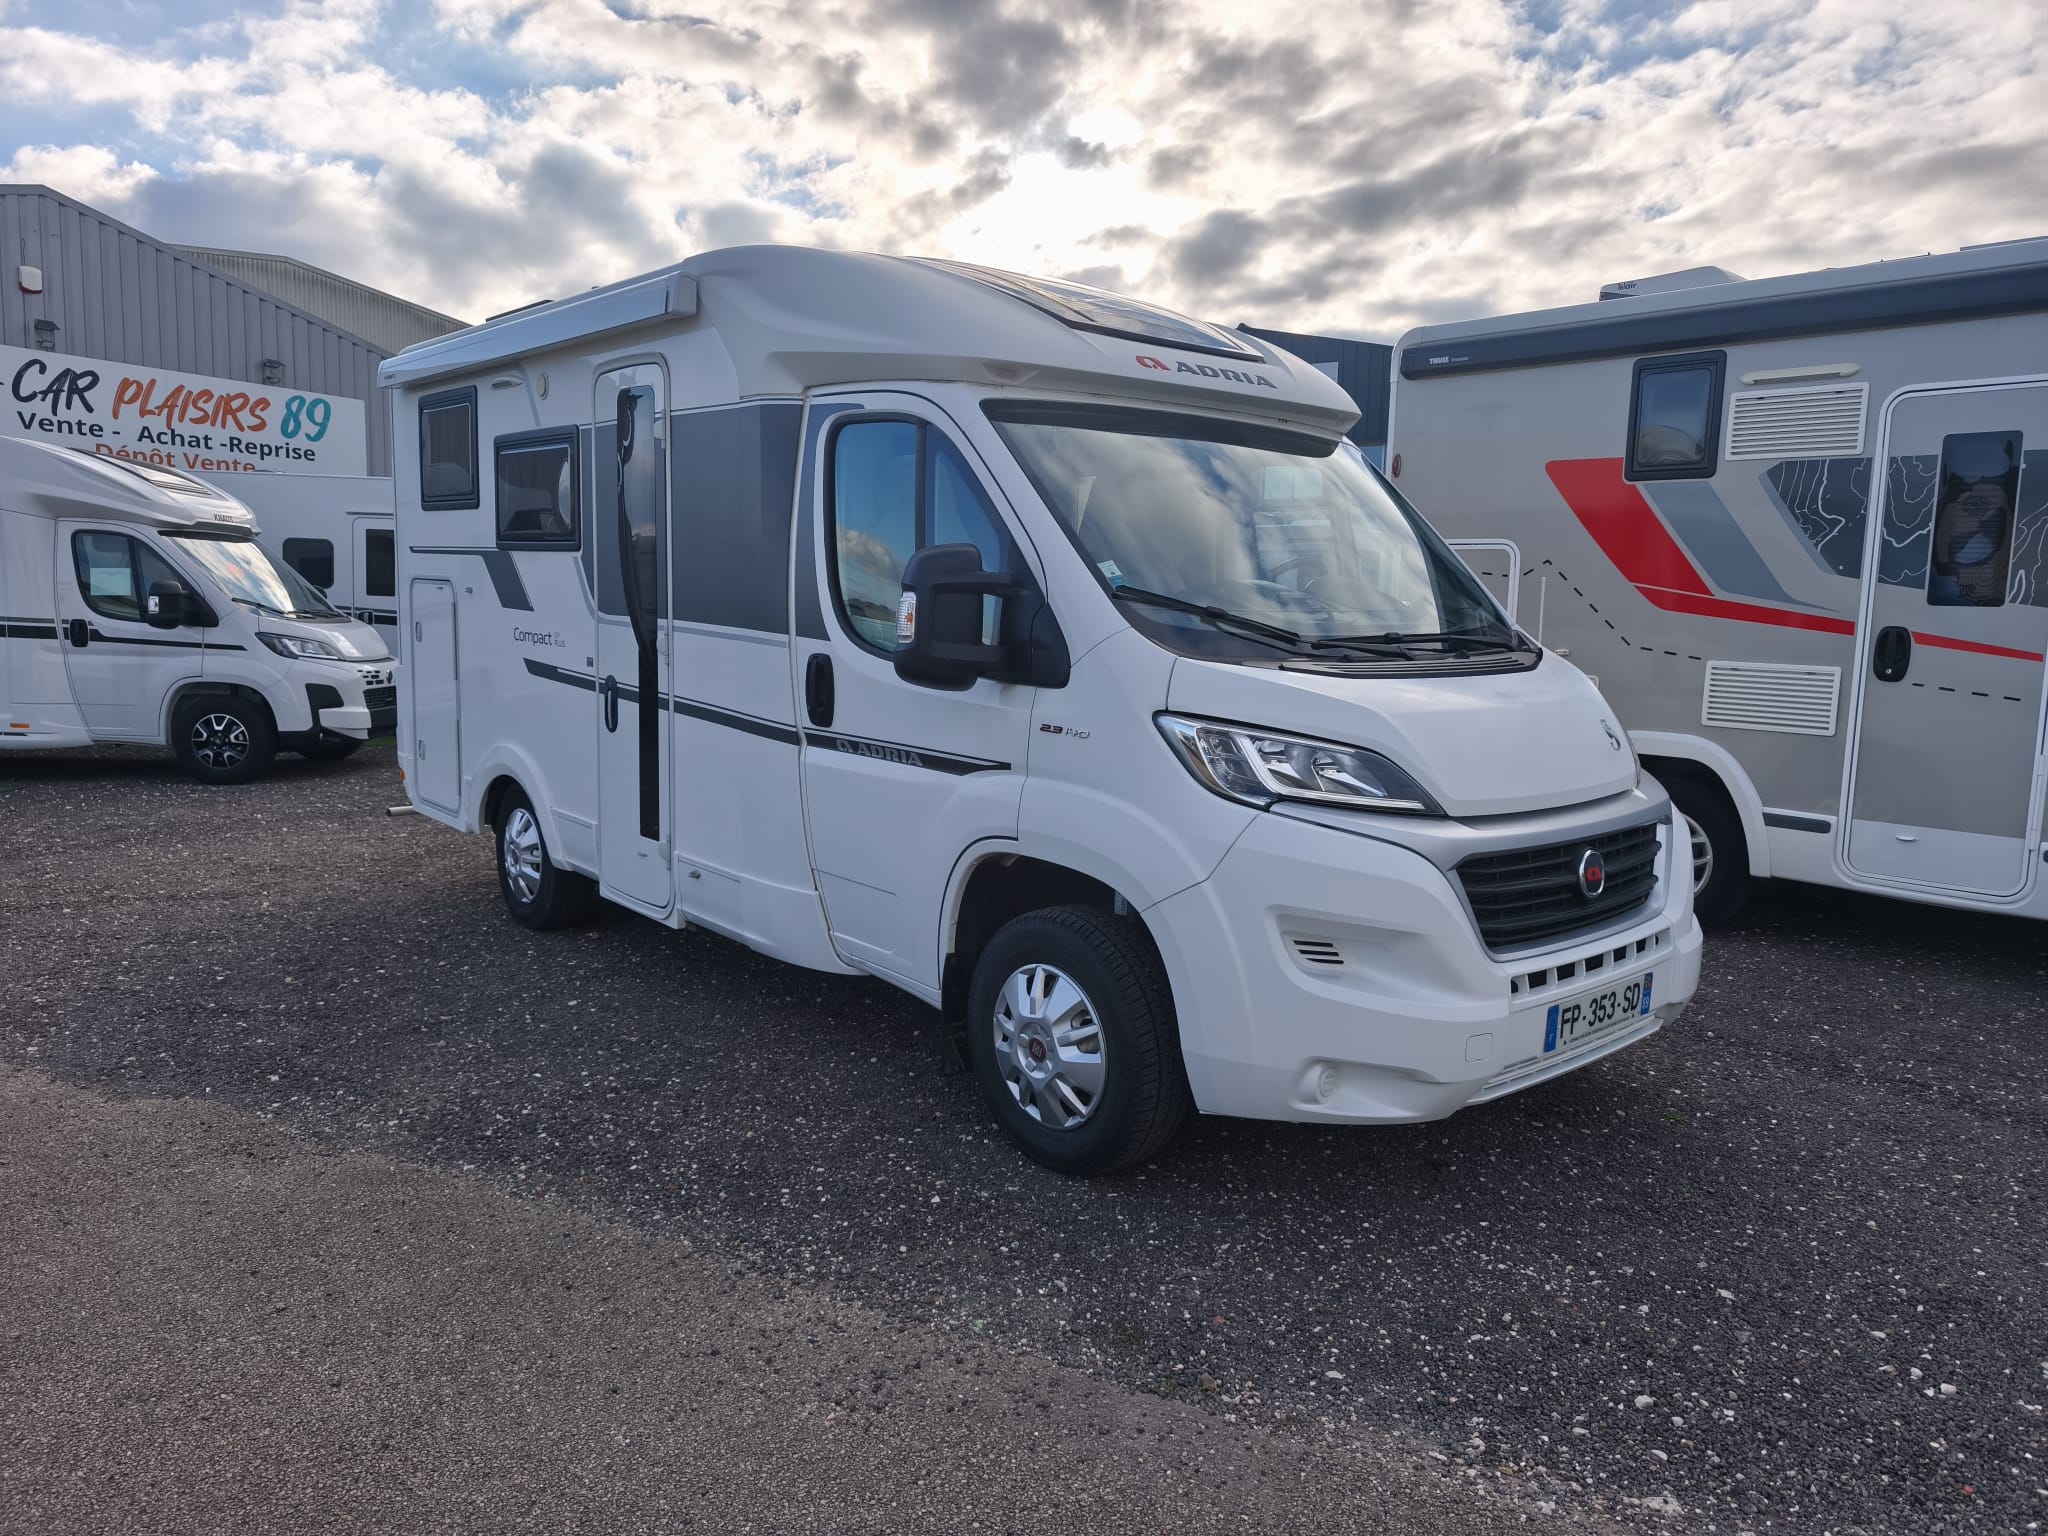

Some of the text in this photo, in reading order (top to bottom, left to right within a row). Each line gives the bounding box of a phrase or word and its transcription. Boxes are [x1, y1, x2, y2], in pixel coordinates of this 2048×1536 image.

[1176, 361, 1278, 389] ADRIA
[12, 358, 331, 442] CAR PLAISIRS 89
[16, 410, 104, 438] Vente
[137, 425, 213, 450] Achat
[182, 451, 256, 472] Vente
[513, 627, 553, 647] Compact
[857, 742, 924, 767] ADRIA
[1560, 982, 1641, 1039] FP-353-SD
